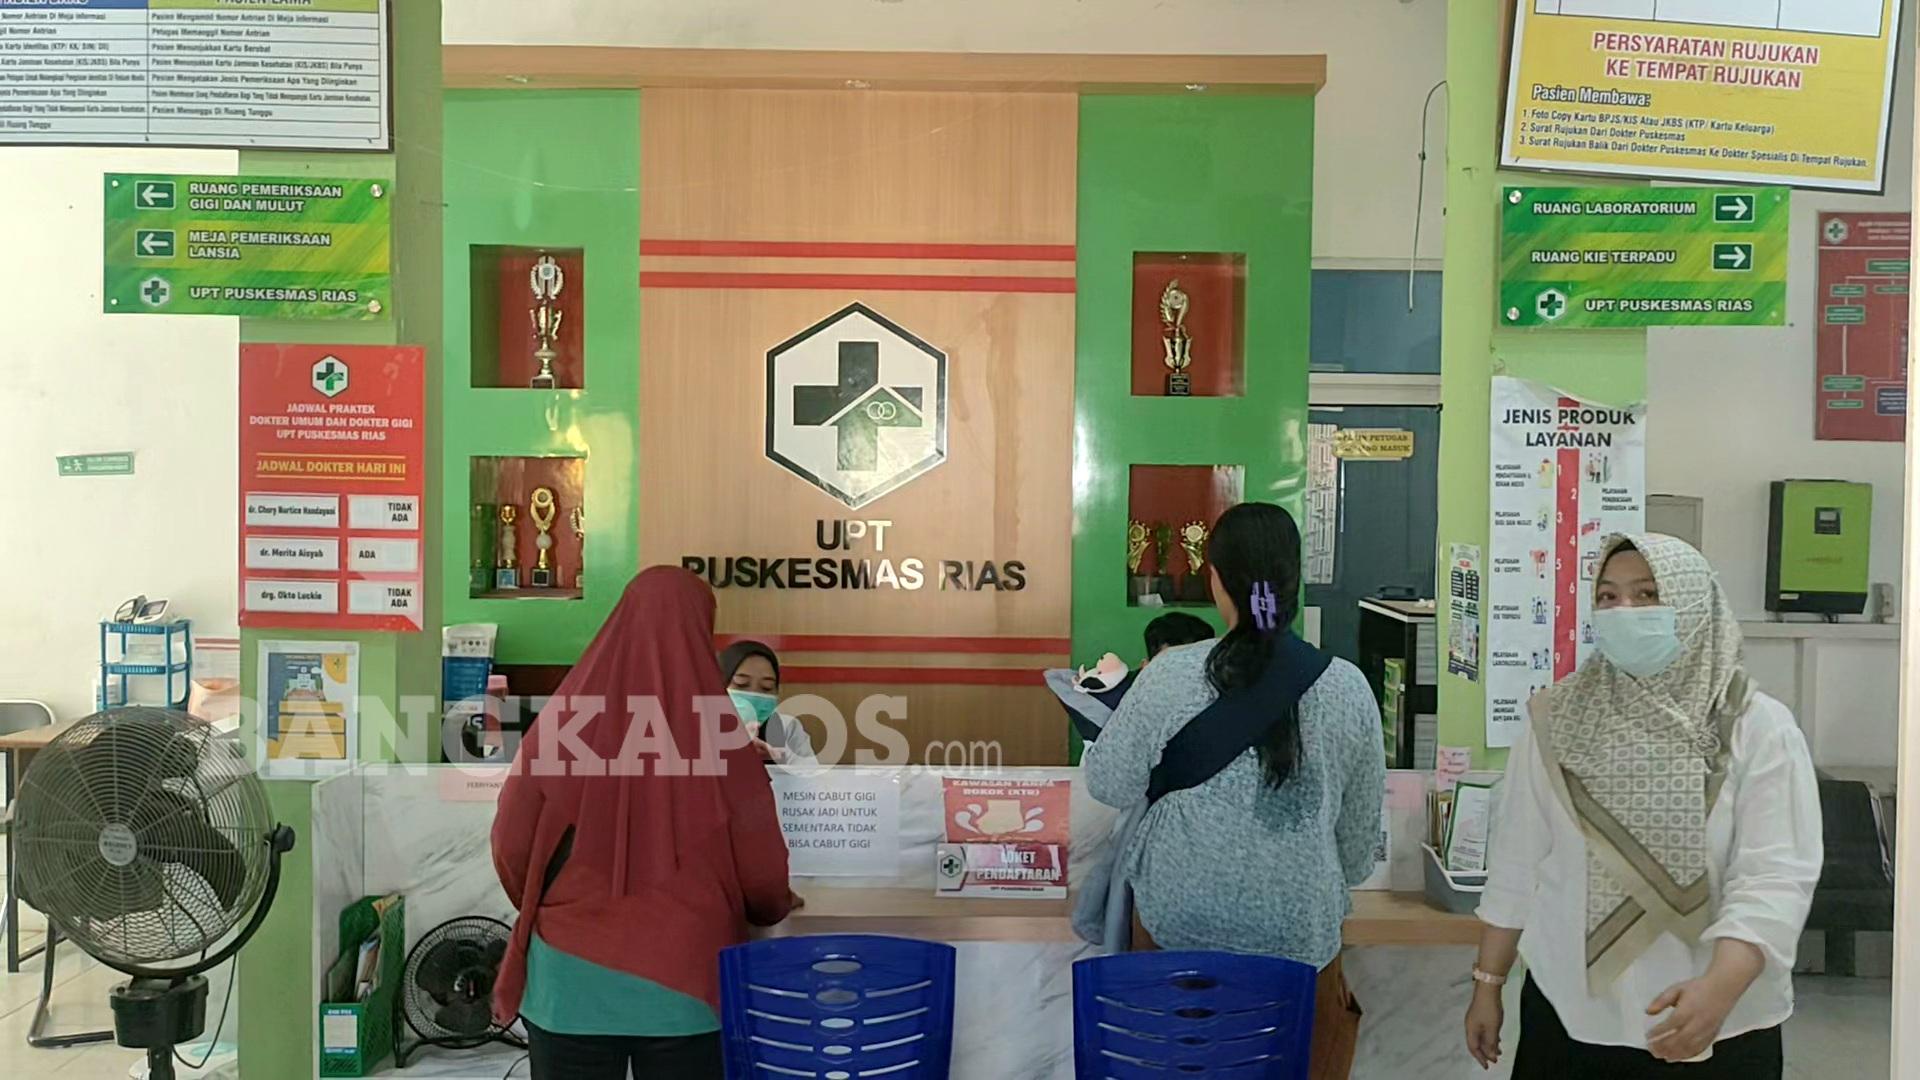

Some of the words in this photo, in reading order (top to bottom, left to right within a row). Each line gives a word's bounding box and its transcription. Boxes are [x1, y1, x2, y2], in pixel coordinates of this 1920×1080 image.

[1593, 32, 1726, 58] PERSYARATAN
[1731, 42, 1819, 65] RUJUKAN
[1606, 58, 1630, 76] KE
[1636, 60, 1709, 82] TEMPAT
[1713, 65, 1801, 88] RUJUKAN
[1532, 84, 1576, 101] Pasien
[1579, 86, 1651, 107] Membawa:
[1531, 109, 1549, 120] Foto
[1552, 110, 1572, 122] Copy
[1574, 112, 1597, 123] Kartu
[1640, 116, 1659, 126] Atau
[1661, 117, 1683, 128] JKBS
[1711, 120, 1733, 131] Kartu
[1530, 122, 1552, 134] Surat
[1554, 124, 1588, 137] Rujukan
[1590, 126, 1608, 136] Dari
[1610, 128, 1637, 138] Dokter
[1640, 130, 1686, 141] Puskesmas
[1528, 136, 1552, 147] Surat
[1554, 138, 1587, 150] Rujukan
[1589, 140, 1609, 150] Balik
[1611, 140, 1629, 151] Dari
[1631, 142, 1658, 153] Dokter
[1660, 144, 1706, 157] Puskesmas
[1709, 147, 1720, 157] Ke
[1722, 148, 1749, 159] Dokter
[1751, 150, 1788, 163] Spesialis
[1790, 152, 1800, 162] Di
[1802, 153, 1832, 166] Tempat
[190, 183, 238, 195] RUANG
[242, 184, 342, 198] PEMERIKSAAN
[190, 198, 220, 210] GIGI
[223, 199, 251, 210] DAN
[256, 200, 304, 212] MULUT
[1532, 202, 1582, 214] RUANG
[1585, 203, 1696, 215] LABORATORIUM
[189, 232, 226, 244] MEJA
[230, 232, 332, 246] PEMERIKSAAN
[189, 247, 241, 260] LANSIA
[1531, 251, 1580, 263] RUANG
[1584, 252, 1607, 263] KIE
[1611, 252, 1676, 263] TERPADU
[190, 288, 219, 300] UPT
[224, 288, 318, 302] PUSKESMAS
[321, 290, 358, 302] RIAS
[1585, 300, 1616, 312] UPT
[1620, 300, 1714, 312] PUSKESMAS
[1717, 300, 1753, 312] RIAS
[287, 403, 327, 414] JADWAL
[330, 404, 375, 414] PRAKTEK
[250, 416, 290, 426] DOKTER
[292, 416, 323, 426] UMUM
[326, 417, 348, 427] DAN
[350, 418, 390, 428] DOKTER
[391, 418, 413, 428] GIGI
[1502, 409, 1552, 424] JENIS
[1558, 409, 1636, 425] PRODUK
[276, 430, 295, 439] UPT
[298, 430, 360, 440] PUSKESMAS
[362, 431, 386, 441] RIAS
[1526, 432, 1612, 448] LAYANAN
[257, 460, 304, 472] JADWAL
[306, 462, 354, 473] DOKTER
[356, 462, 386, 474] HARI
[389, 463, 406, 474] INI
[1571, 488, 1578, 500] 2
[388, 502, 412, 512] TIDAK
[392, 514, 409, 522] ADA
[1557, 512, 1563, 524] 3
[816, 519, 893, 552] UPT
[1569, 535, 1576, 548] 4
[260, 548, 270, 557] dr.
[358, 550, 376, 560] ADA
[682, 556, 925, 591] PUSKESMAS
[938, 559, 1027, 592] RIAS
[388, 588, 412, 598] TIDAK
[1569, 582, 1576, 594] 6
[261, 590, 276, 602] drg.
[390, 599, 408, 608] ADA
[1556, 604, 1561, 617] 7
[1569, 628, 1576, 641] 8
[1554, 652, 1560, 664] 9
[952, 780, 1012, 788] KAWASAN
[783, 791, 816, 801] MESIN
[818, 791, 852, 801] CABUT
[854, 791, 876, 801] GIGI
[962, 788, 1004, 796] ROKOK
[782, 807, 816, 817] RUSAK
[817, 807, 840, 817] JADI
[841, 807, 878, 817] UNTUK
[782, 823, 844, 833] SEMENTARA
[847, 823, 877, 833] TIDAK
[788, 839, 810, 849] BISA
[812, 839, 847, 849] CABUT
[849, 839, 871, 849] GIGI
[1000, 850, 1036, 864] LOKET
[976, 868, 1062, 881] PENDAFTARAN
